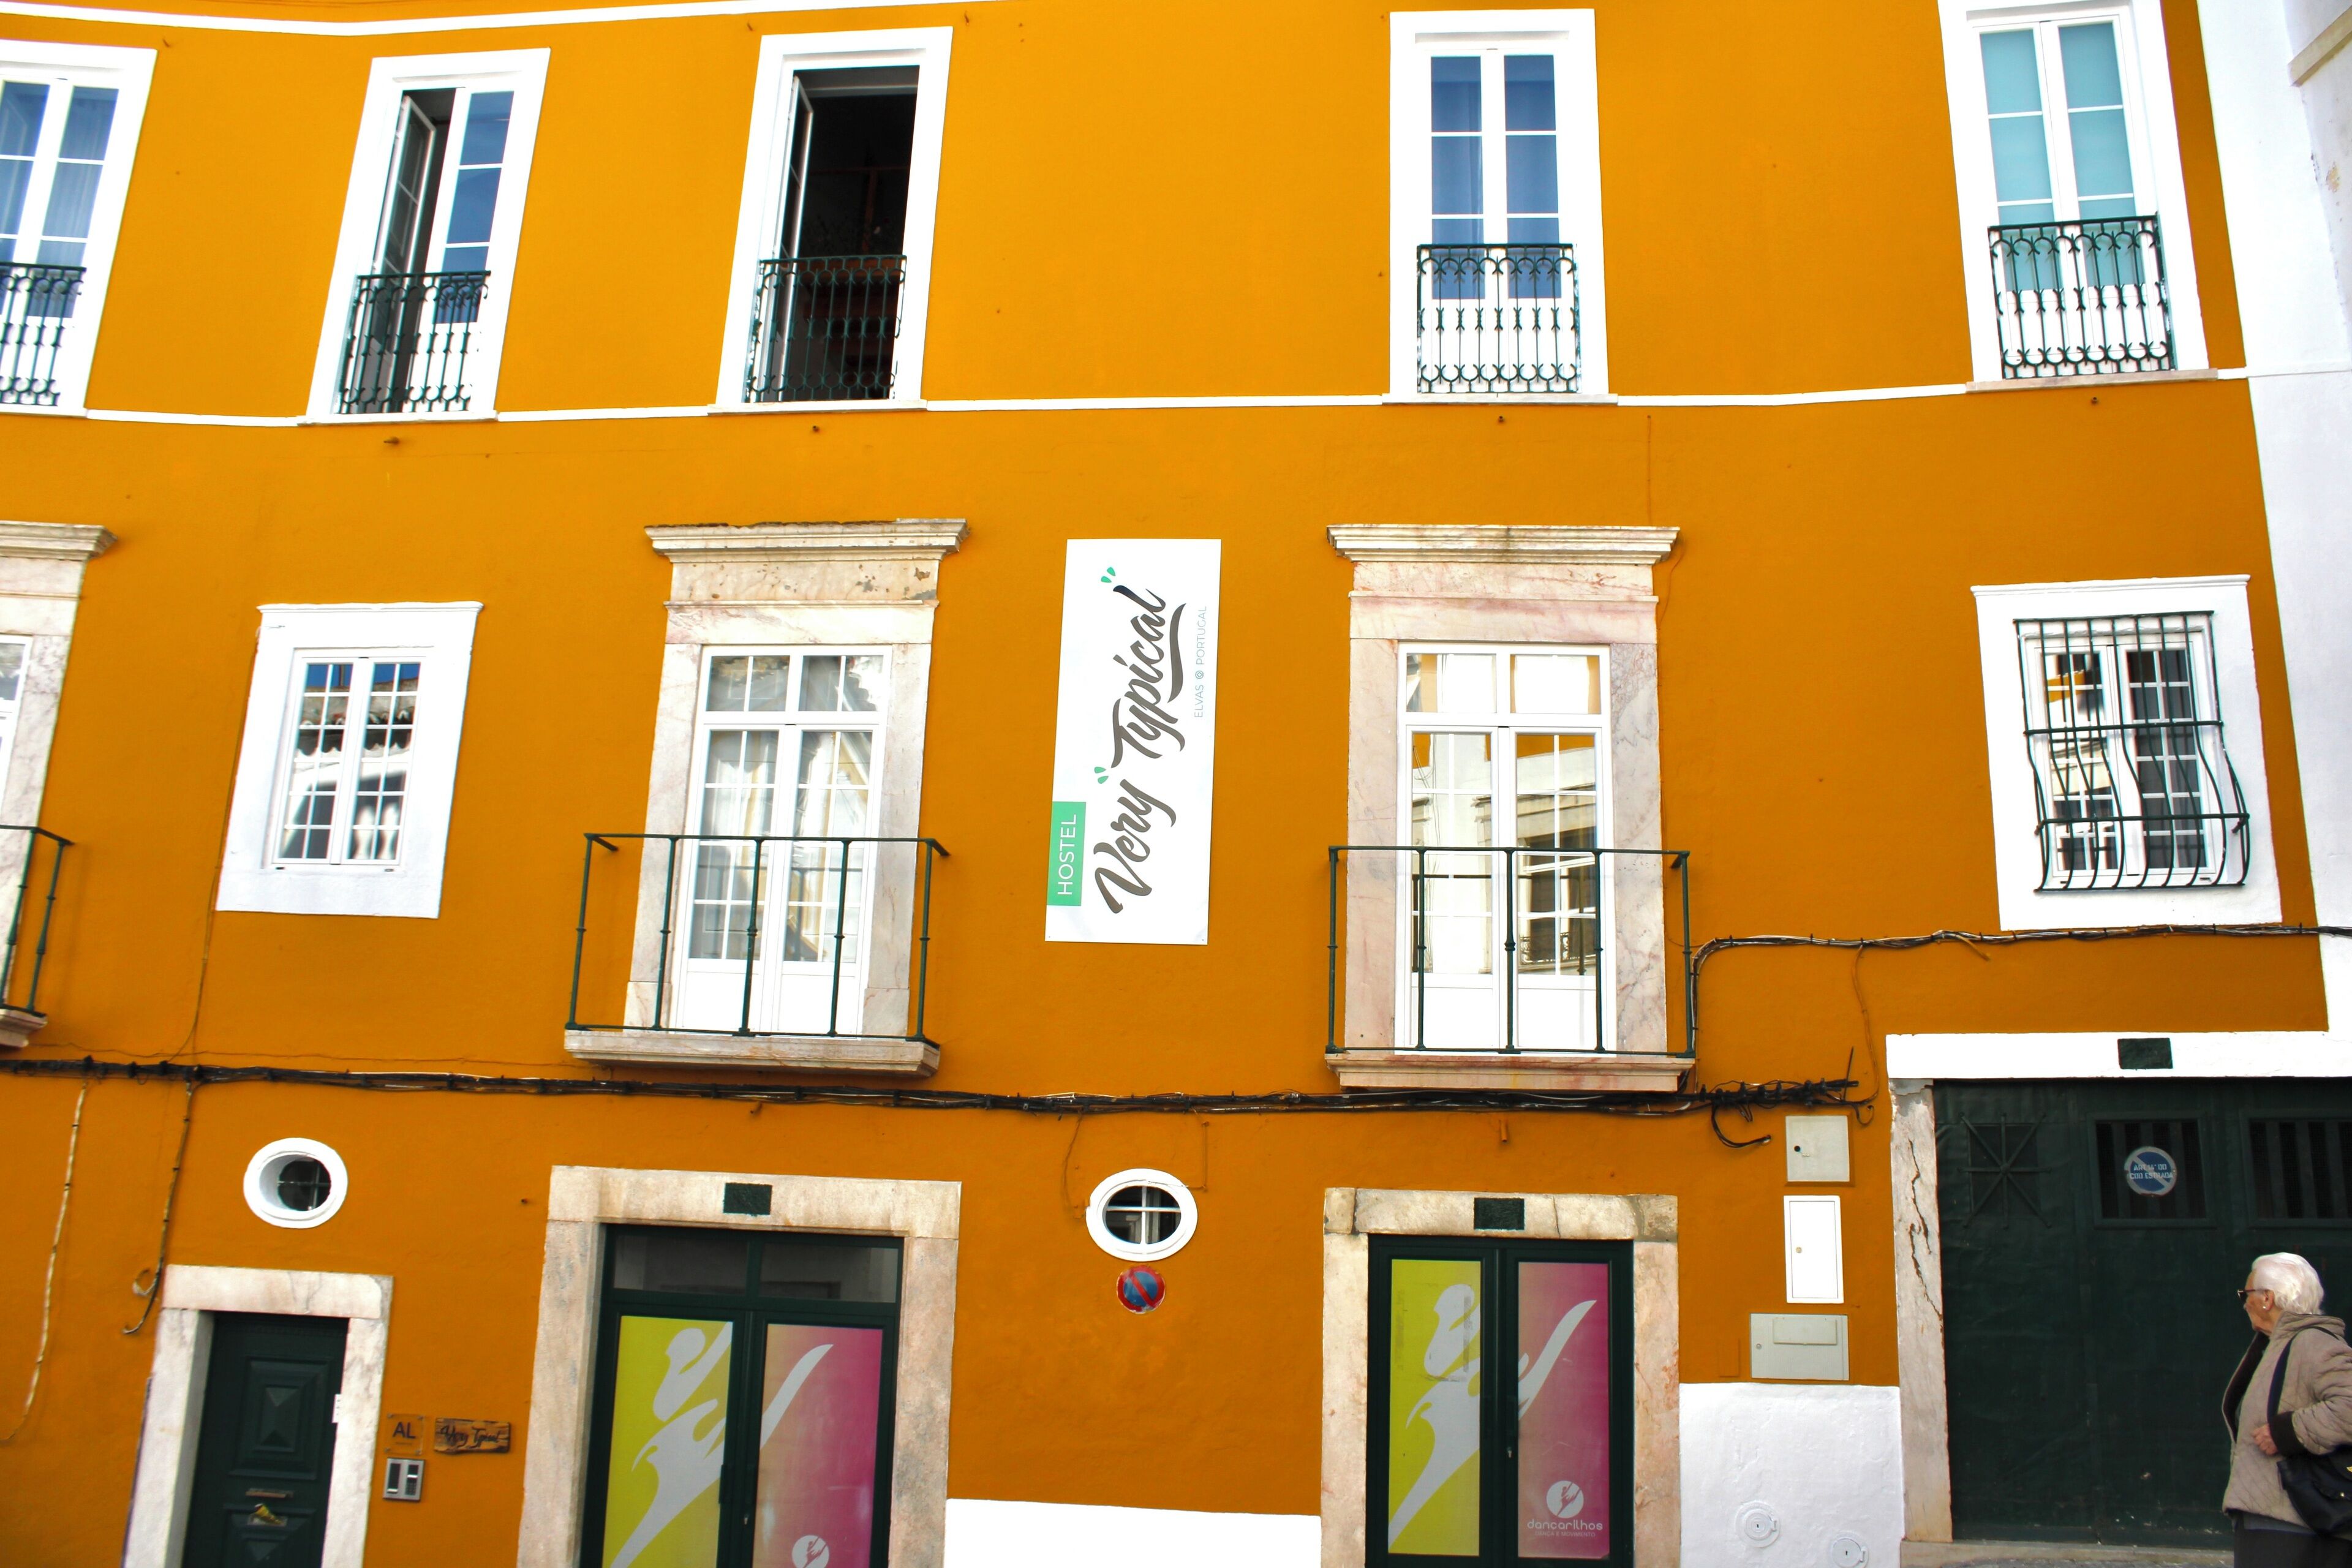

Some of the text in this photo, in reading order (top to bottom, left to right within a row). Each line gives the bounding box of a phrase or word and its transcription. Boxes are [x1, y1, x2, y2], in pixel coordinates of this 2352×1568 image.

[1194, 606, 1207, 718] ELVAS PORTUGAL
[1093, 585, 1186, 914] Very Typical
[1057, 814, 1077, 895] HOSTEL
[392, 1422, 417, 1439] AL
